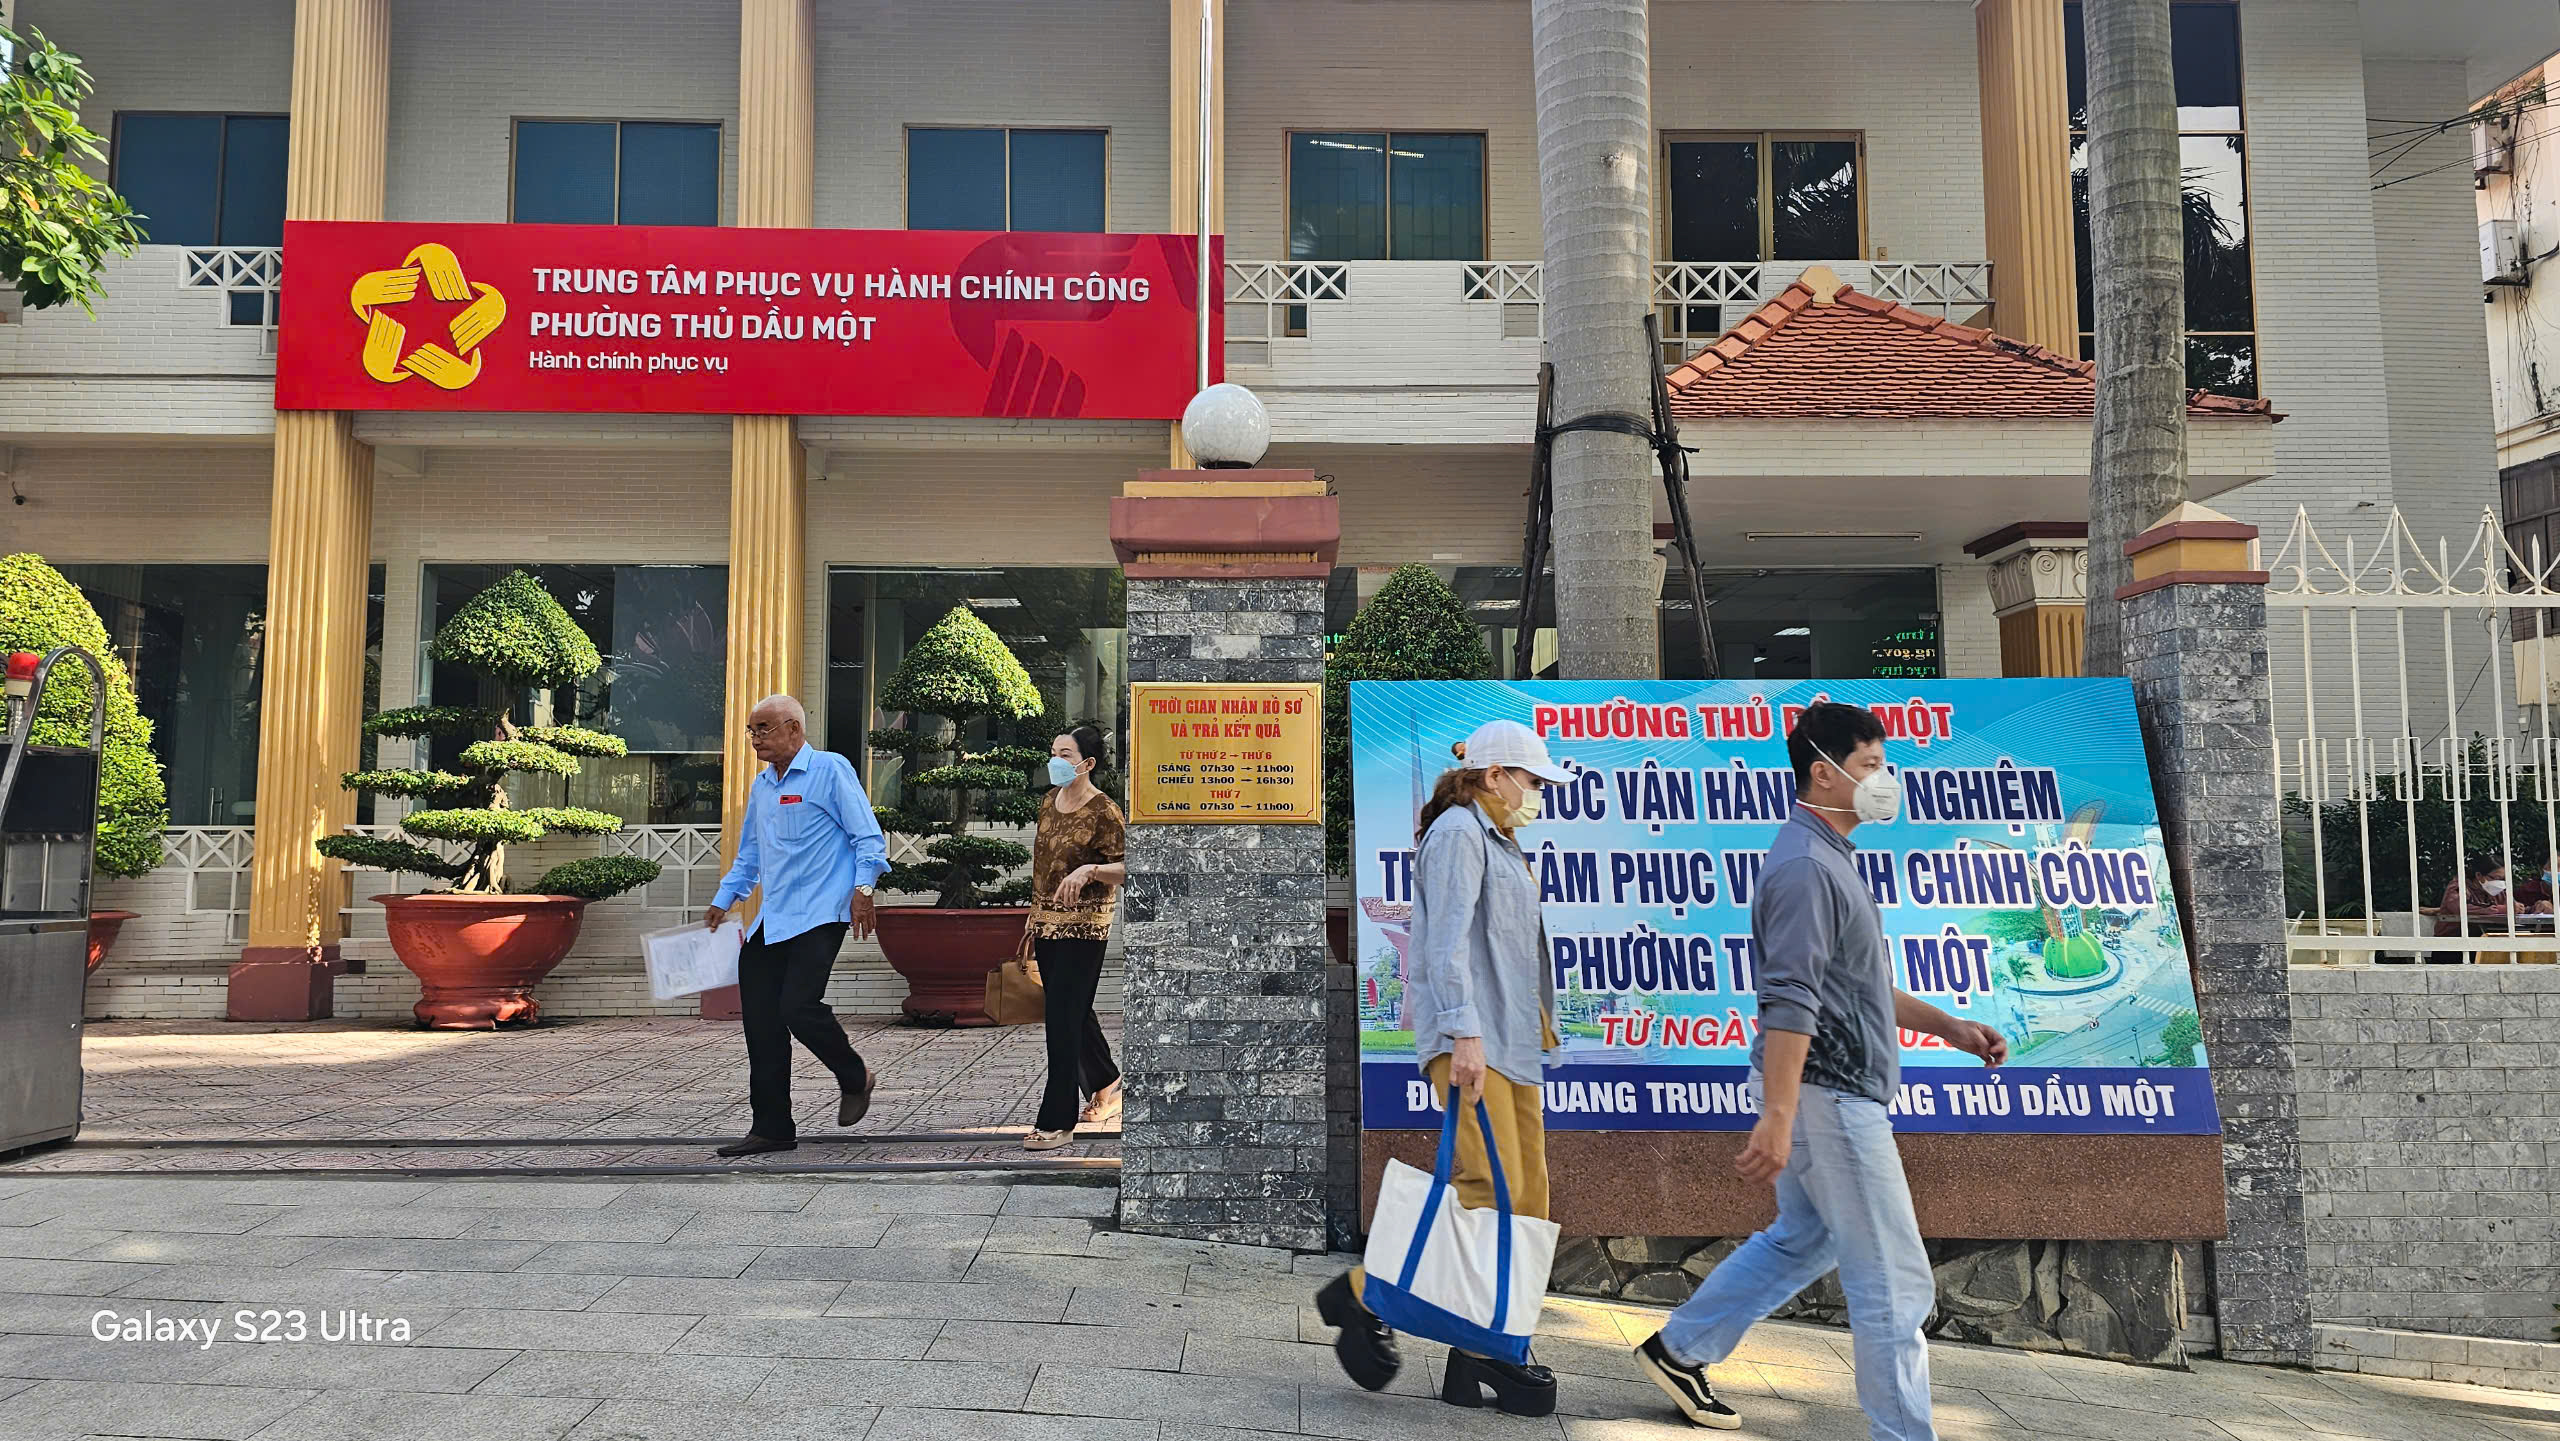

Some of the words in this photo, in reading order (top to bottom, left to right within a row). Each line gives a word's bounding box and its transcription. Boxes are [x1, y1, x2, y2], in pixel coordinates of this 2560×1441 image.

[533, 268, 638, 294] TRUNG
[646, 264, 707, 294] TÂM
[715, 271, 801, 302] PHỤC
[811, 272, 855, 303] VỤ
[865, 267, 951, 299] HÀNH
[960, 269, 1054, 300] CHÍNH
[1064, 271, 1150, 302] CÔNG
[530, 304, 661, 338] PHƯỜNG
[671, 306, 734, 339] THỦ
[742, 305, 804, 340] DẦU
[812, 310, 876, 347] MỘT
[529, 351, 581, 370] Hành
[586, 351, 642, 371] chính
[648, 354, 699, 374] phục
[703, 355, 728, 374] vụ
[1149, 696, 1182, 714] THỜI
[1186, 700, 1217, 714] GIAN
[1221, 696, 1258, 718] NHẬN
[1263, 694, 1281, 714] HỒ
[1284, 697, 1303, 714] SƠ
[1534, 698, 1690, 738] PHƯỜNG
[1699, 695, 1771, 738] THỦ
[1870, 696, 1952, 745] MỘT
[1170, 719, 1188, 737] VÀ
[1192, 717, 1219, 737] TRẢ
[1225, 717, 1251, 738] KẾT
[1255, 717, 1281, 739] QUẢ
[1157, 763, 1191, 773] (SÁNG
[1200, 764, 1235, 773] 07h30
[1256, 764, 1294, 774] 11h00)
[1219, 751, 1227, 760] 2
[1265, 751, 1272, 760] 6
[1200, 776, 1235, 784] 13h00
[1256, 776, 1294, 785] 16h30)
[1234, 790, 1241, 799] 7
[1615, 760, 1696, 832] VẬN
[1904, 759, 2062, 832] NGHIỆM
[1157, 800, 1191, 812] (SÁNG
[1200, 803, 1235, 811] 07h30
[1256, 803, 1294, 812] 11h00)
[1611, 851, 1715, 916] PHỤC
[1907, 841, 2033, 905] CHÍNH
[2040, 841, 2154, 905] CÔNG
[1553, 923, 1716, 992] PHƯỜNG
[1904, 930, 1989, 1005] MỘT
[1601, 1008, 1655, 1046] TỪ
[1942, 1073, 2011, 1116] THỦ
[2020, 1073, 2091, 1118] DẦU
[2104, 1077, 2176, 1124] MỘT
